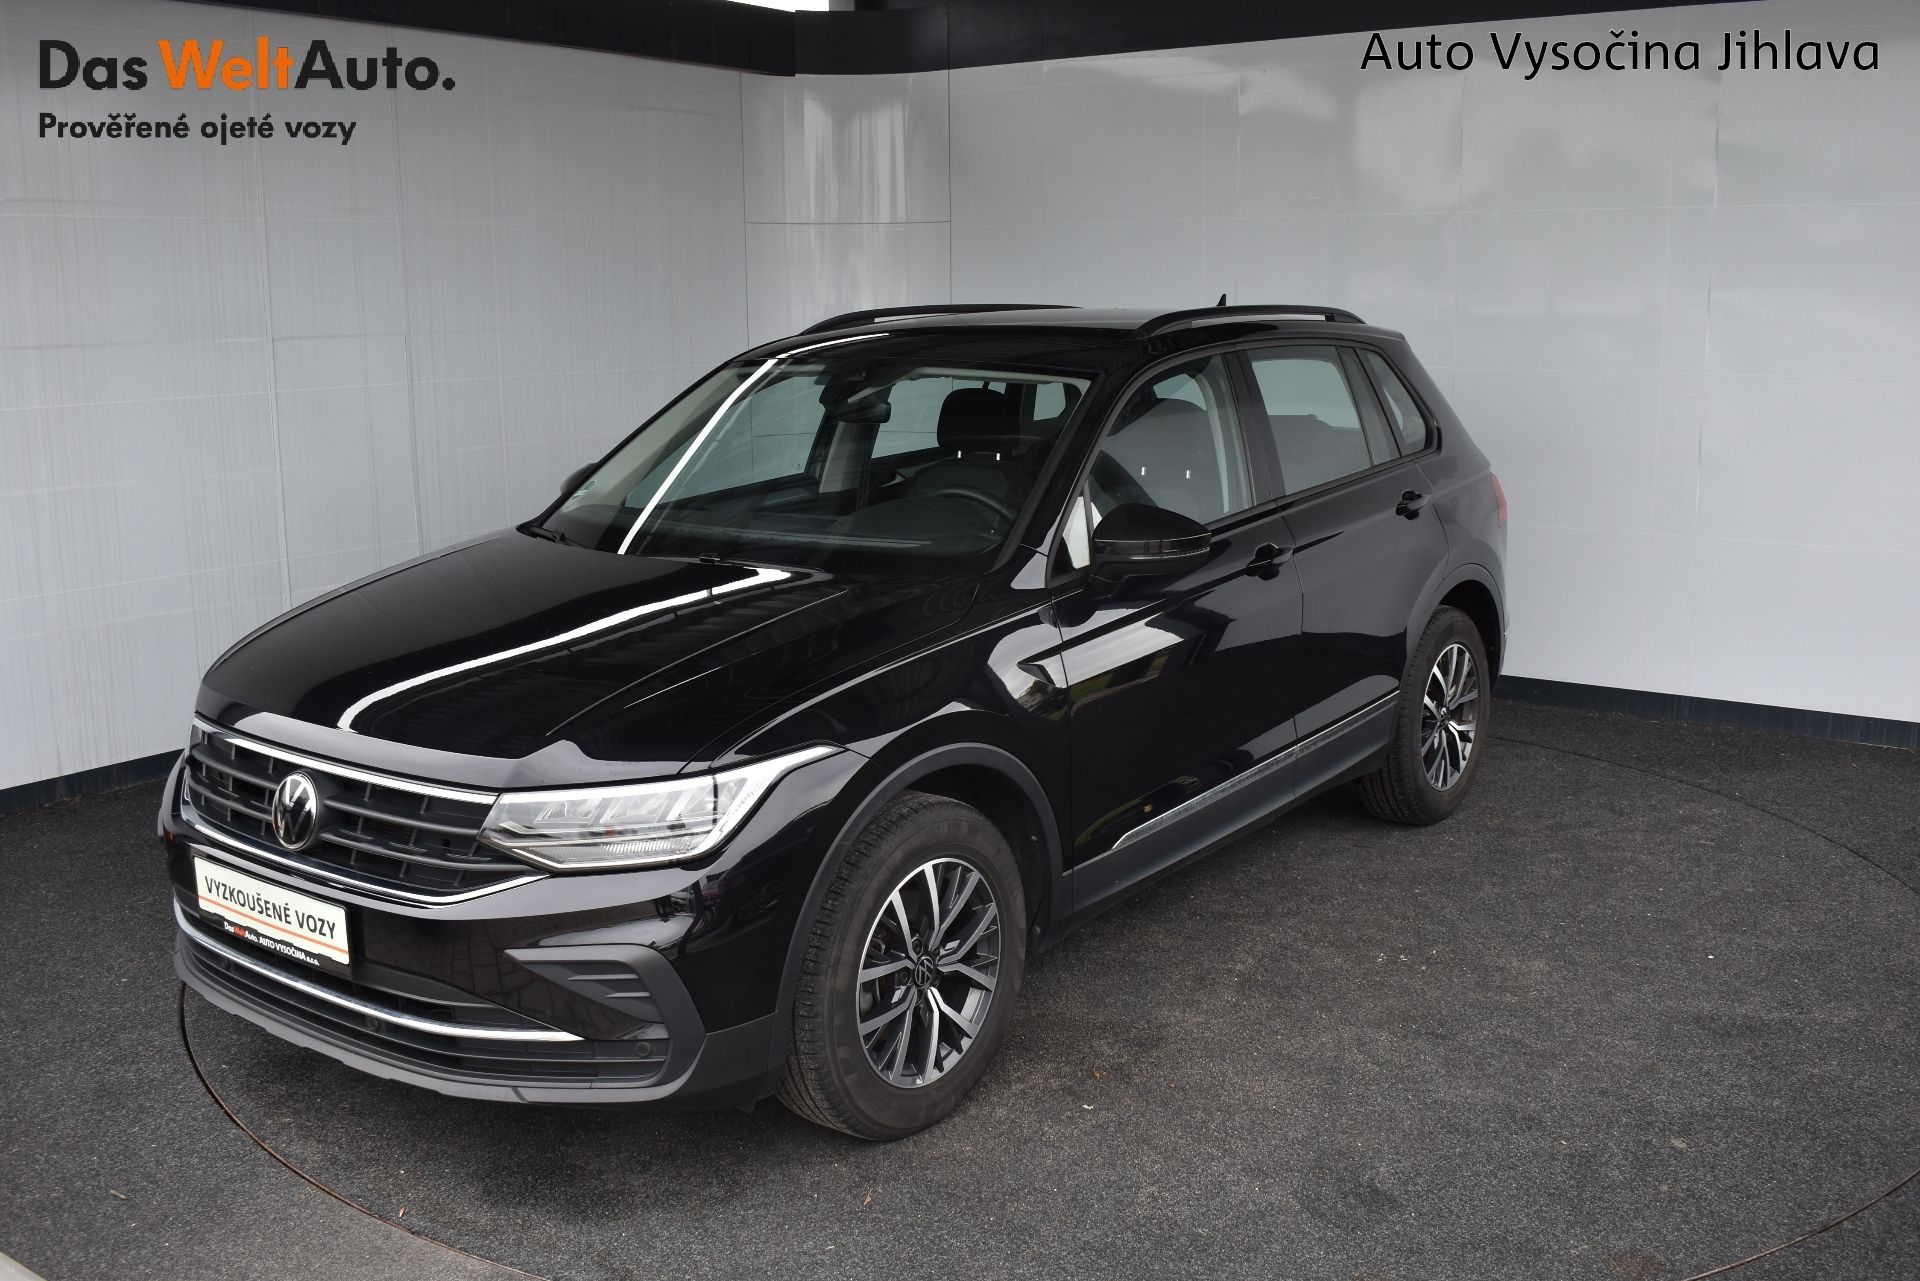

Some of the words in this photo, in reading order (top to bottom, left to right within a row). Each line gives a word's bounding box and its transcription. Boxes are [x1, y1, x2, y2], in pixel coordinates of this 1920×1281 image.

[204, 875, 292, 925] VYZKOUŠENÉ
[294, 909, 336, 939] VOZY
[259, 936, 275, 949] AUTO
